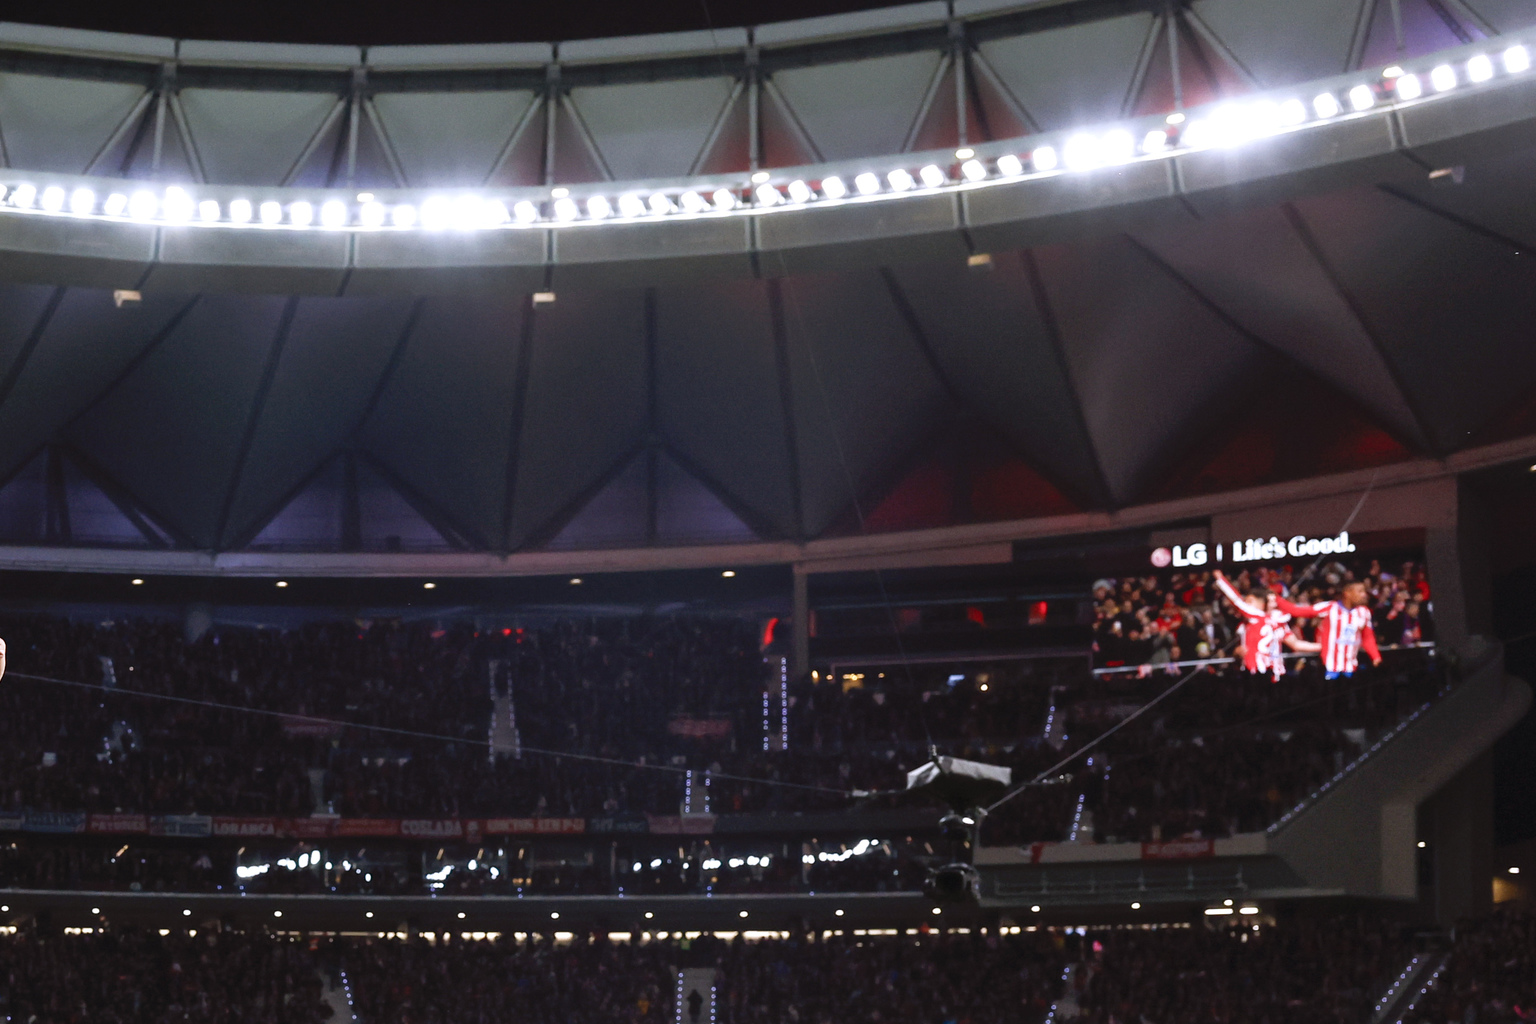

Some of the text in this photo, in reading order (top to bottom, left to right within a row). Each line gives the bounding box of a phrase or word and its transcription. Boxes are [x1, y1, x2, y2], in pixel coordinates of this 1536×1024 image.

[1172, 531, 1356, 567] LG Life's Good.
